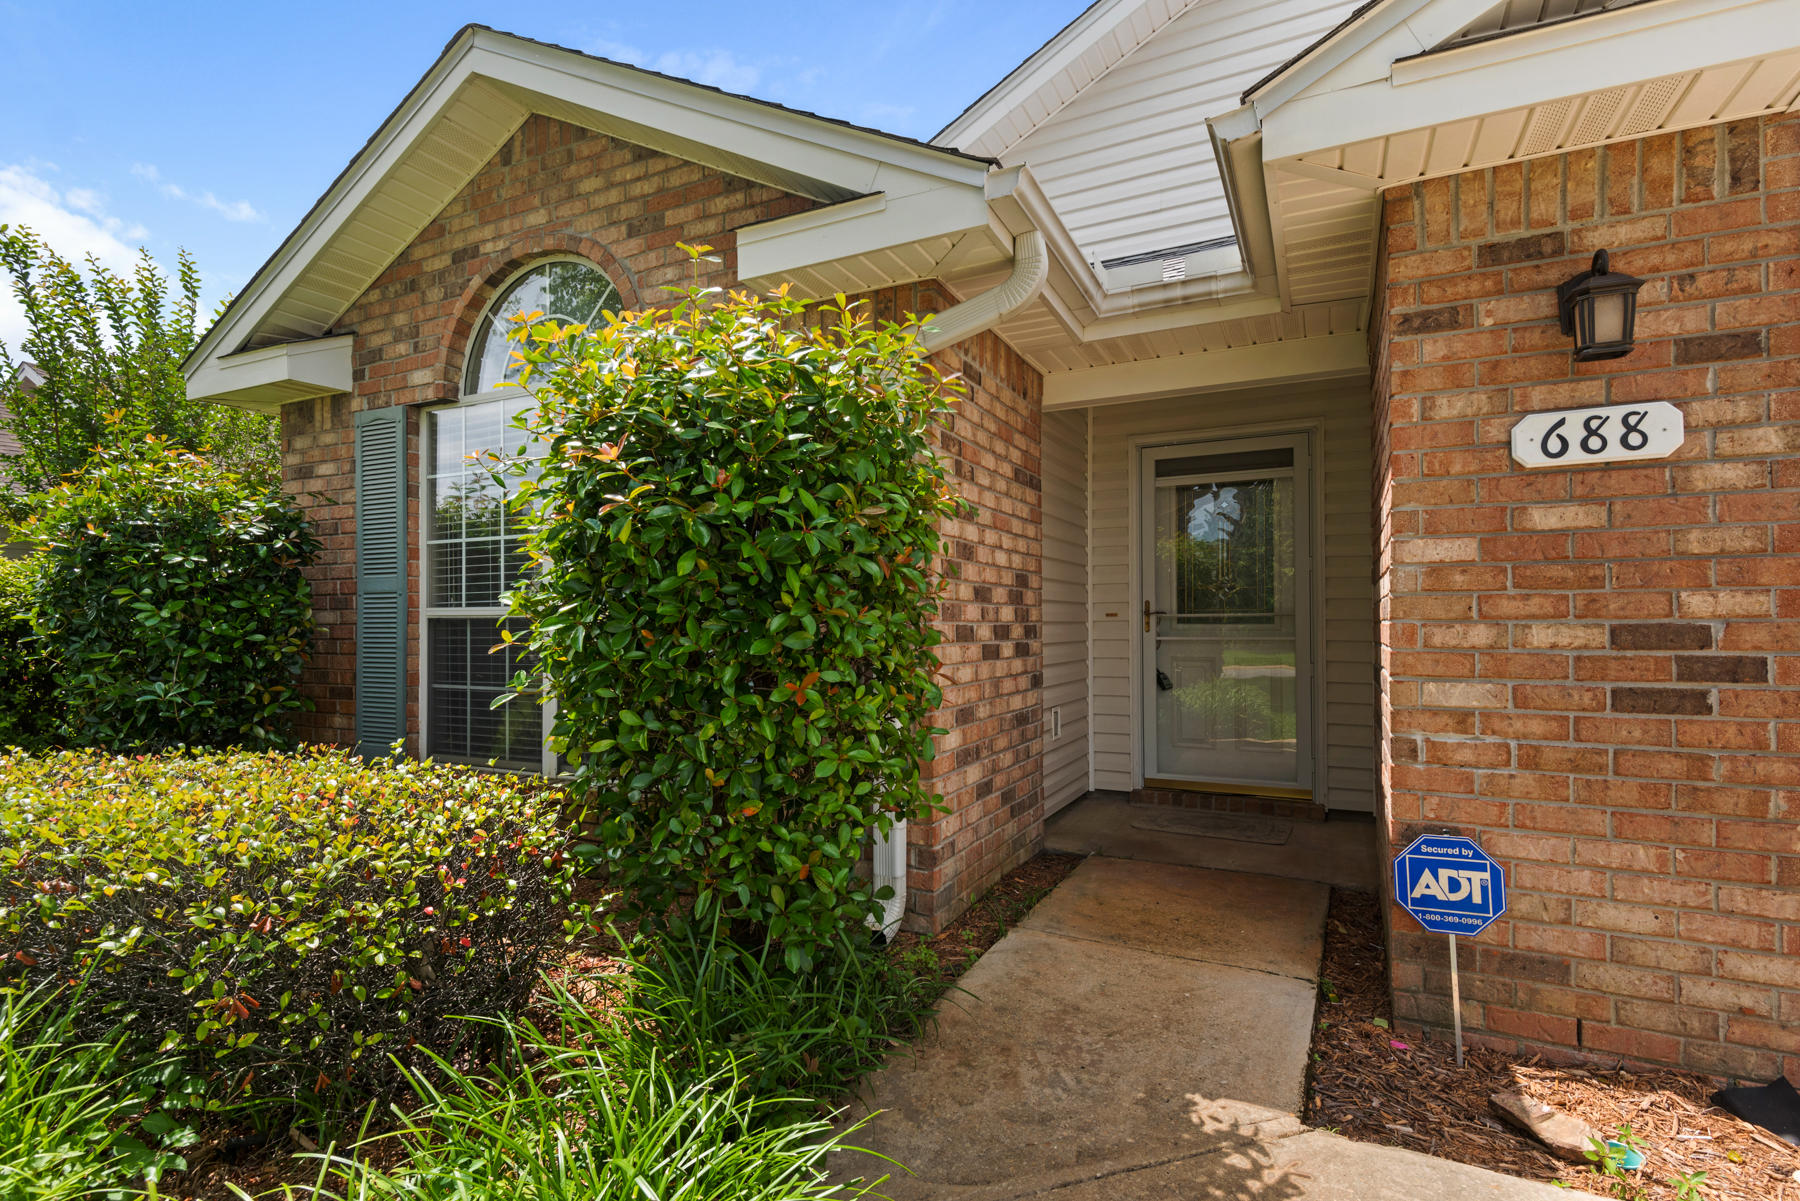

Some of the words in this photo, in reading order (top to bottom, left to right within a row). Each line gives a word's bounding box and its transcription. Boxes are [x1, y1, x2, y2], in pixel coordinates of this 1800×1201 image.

[1540, 410, 1649, 459] 688
[1420, 844, 1460, 855] Secured
[1461, 847, 1474, 858] by
[1410, 867, 1489, 904] ADT
